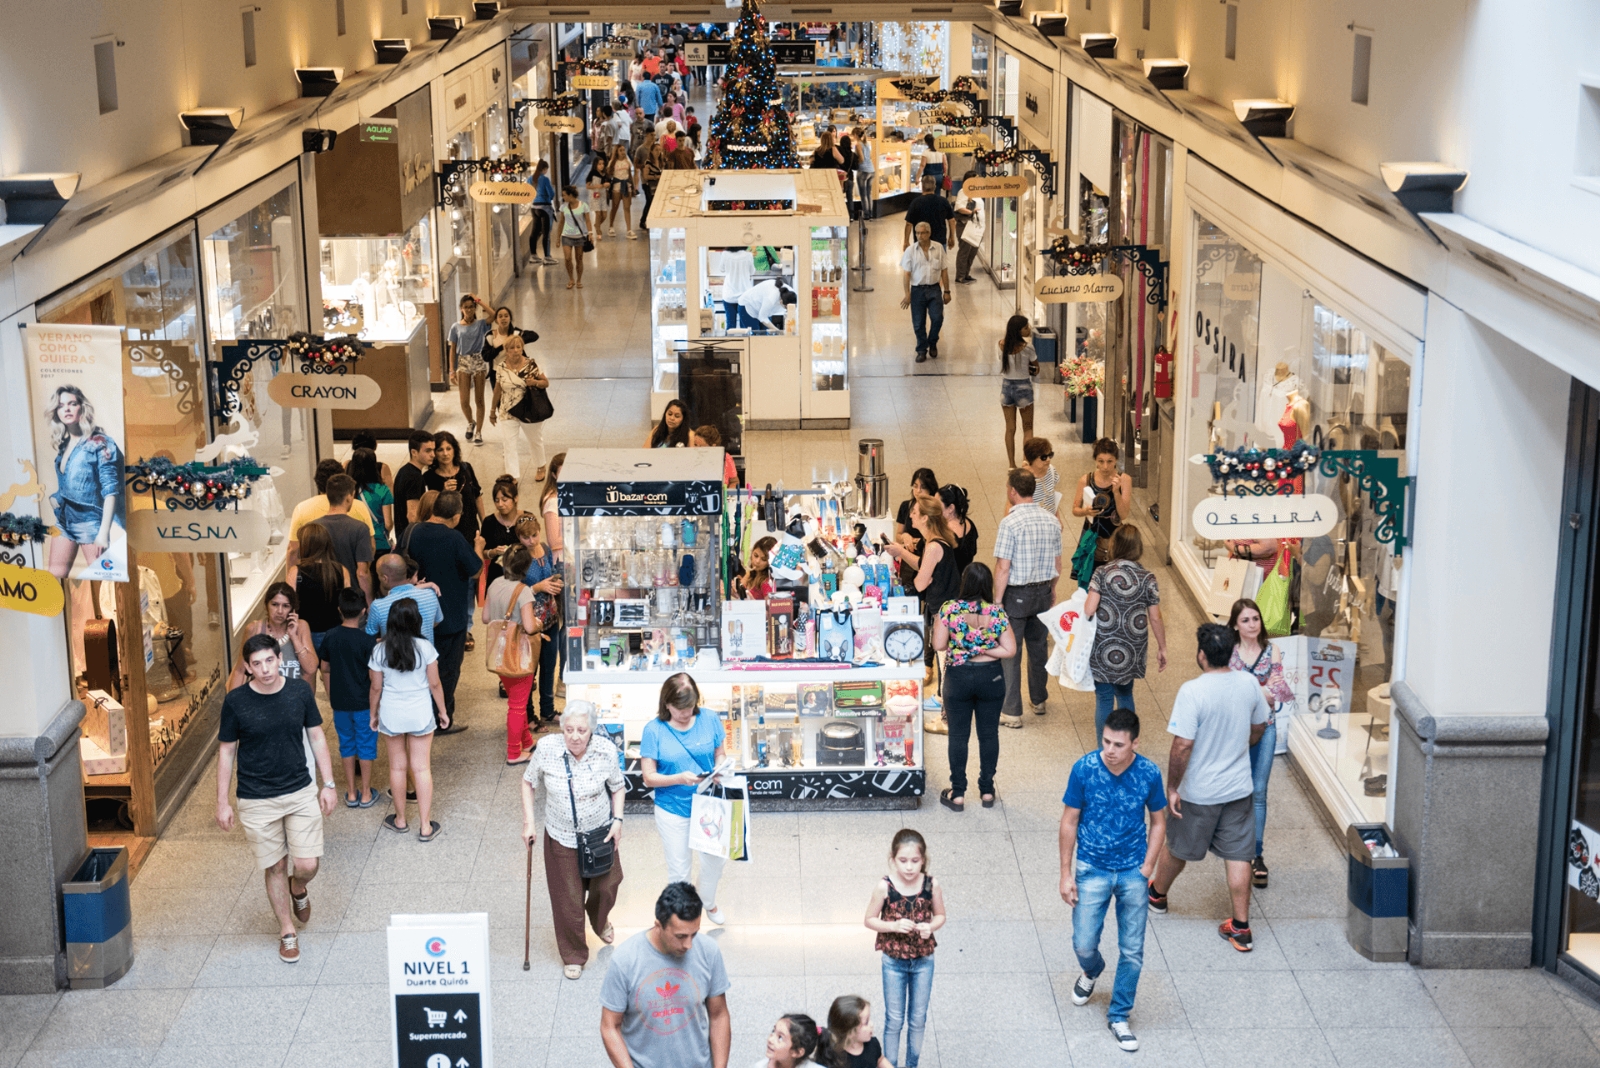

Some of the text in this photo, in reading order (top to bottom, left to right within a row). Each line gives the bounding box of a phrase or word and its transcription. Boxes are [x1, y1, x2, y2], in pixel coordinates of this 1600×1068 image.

[478, 188, 495, 196] Van
[1039, 282, 1115, 296] Luciano Marra
[38, 332, 92, 343] VERANO
[39, 343, 77, 353] COMO
[1196, 311, 1246, 383] OSSIRA
[39, 354, 96, 364] QUIERAS
[291, 385, 357, 400] CRAYON
[619, 492, 668, 502] bazar.com
[1206, 509, 1322, 526] OSSIRA
[156, 522, 238, 541] VESNA
[404, 960, 470, 975] NIVEL 1
[406, 977, 469, 987] Duarte Quirós
[409, 1031, 467, 1041] Supermercado
